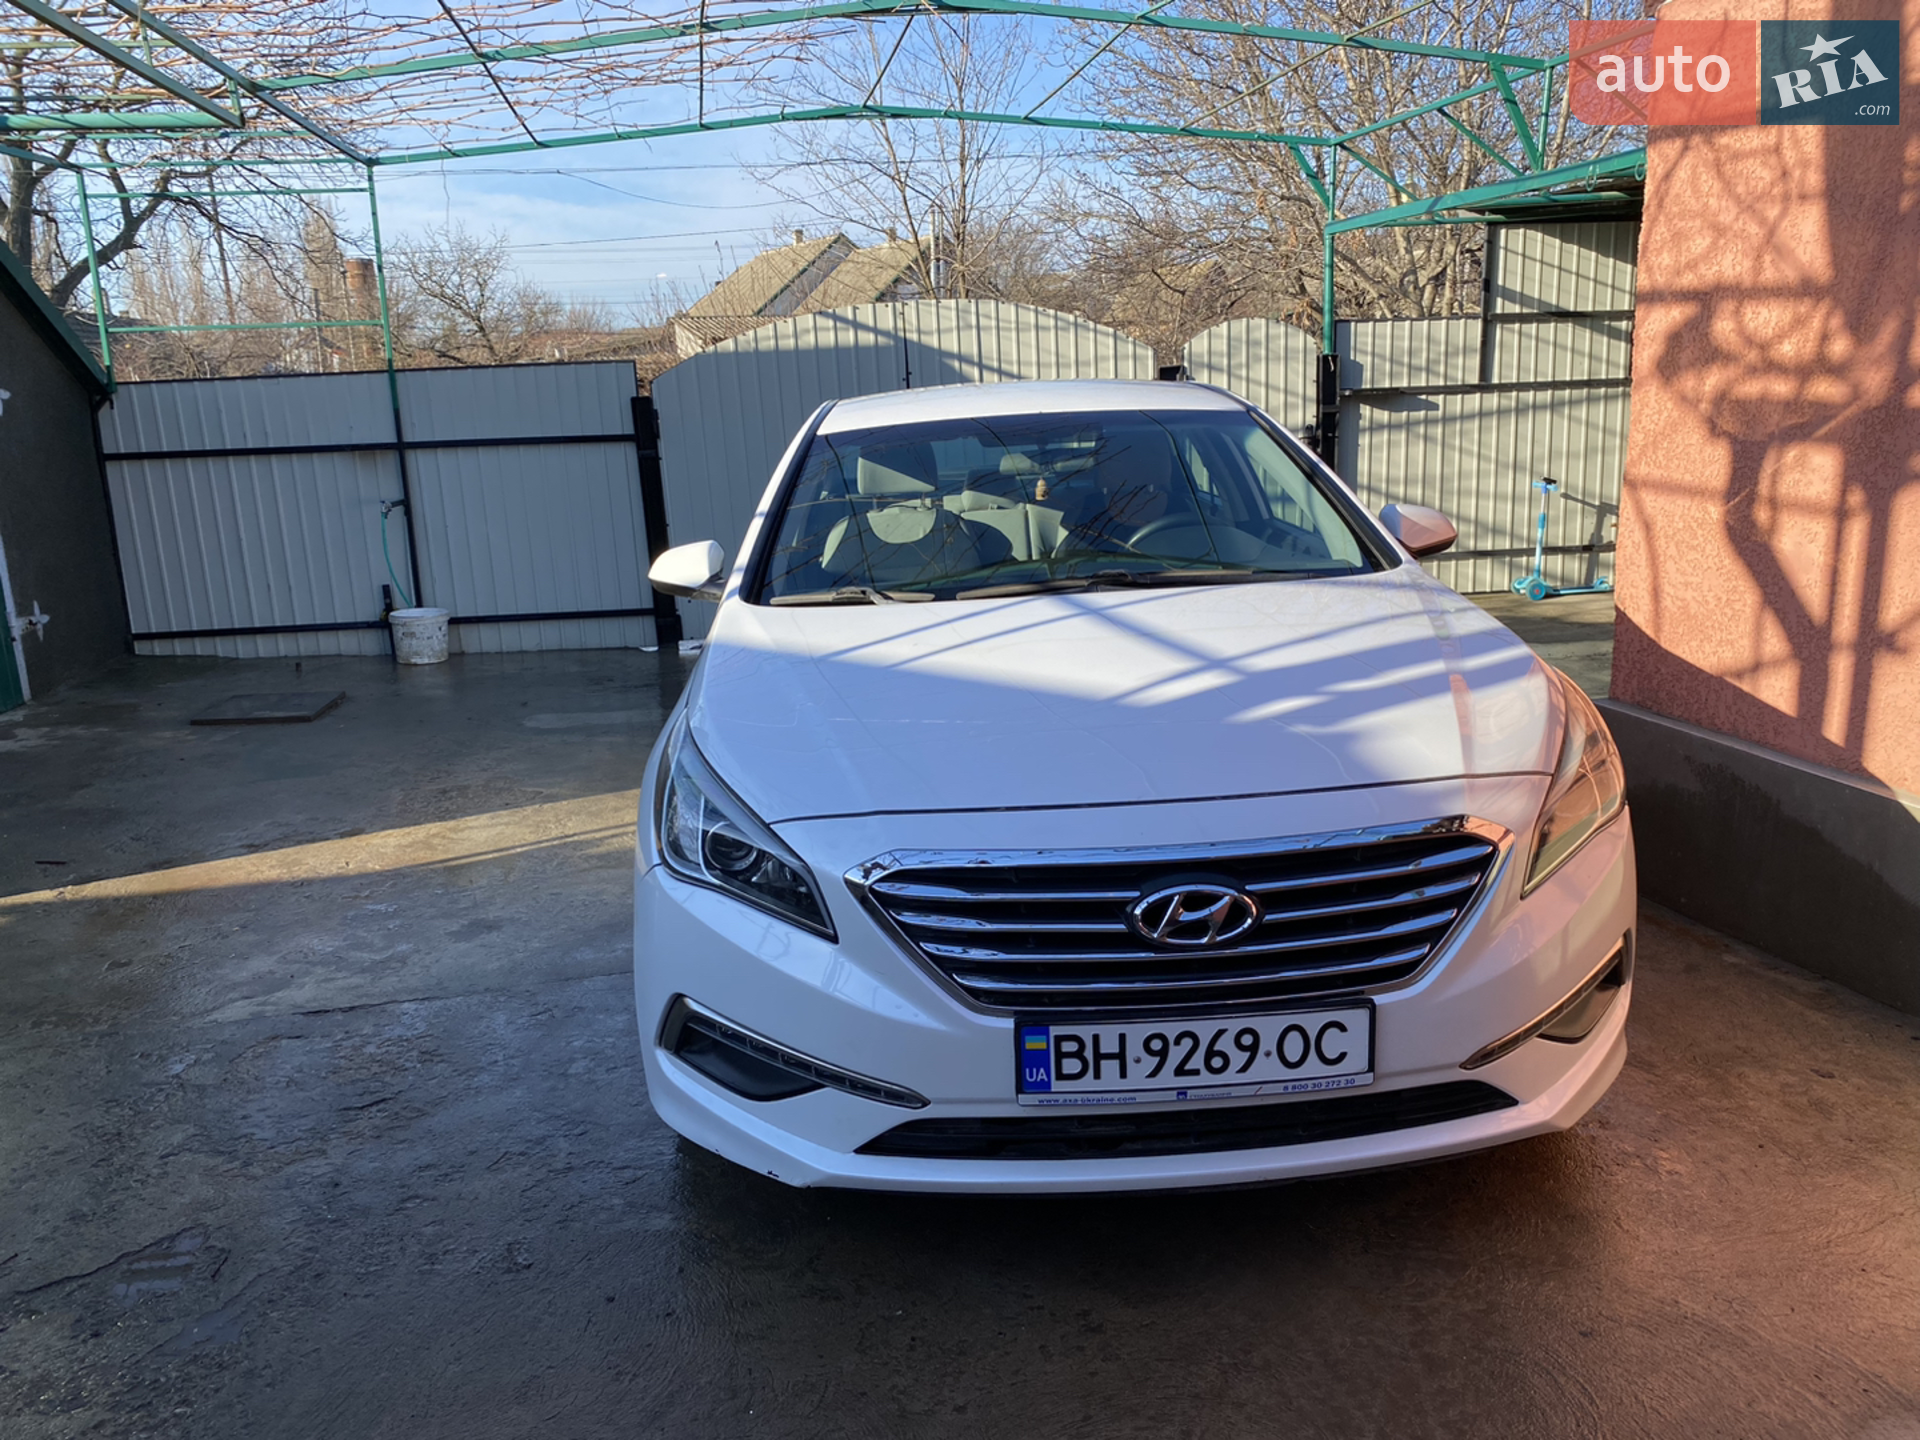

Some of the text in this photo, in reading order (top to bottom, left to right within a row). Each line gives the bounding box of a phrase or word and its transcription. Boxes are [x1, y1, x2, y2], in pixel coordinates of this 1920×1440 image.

[1053, 1020, 1349, 1082] BH 9269 OC
[1025, 1067, 1048, 1082] UA
